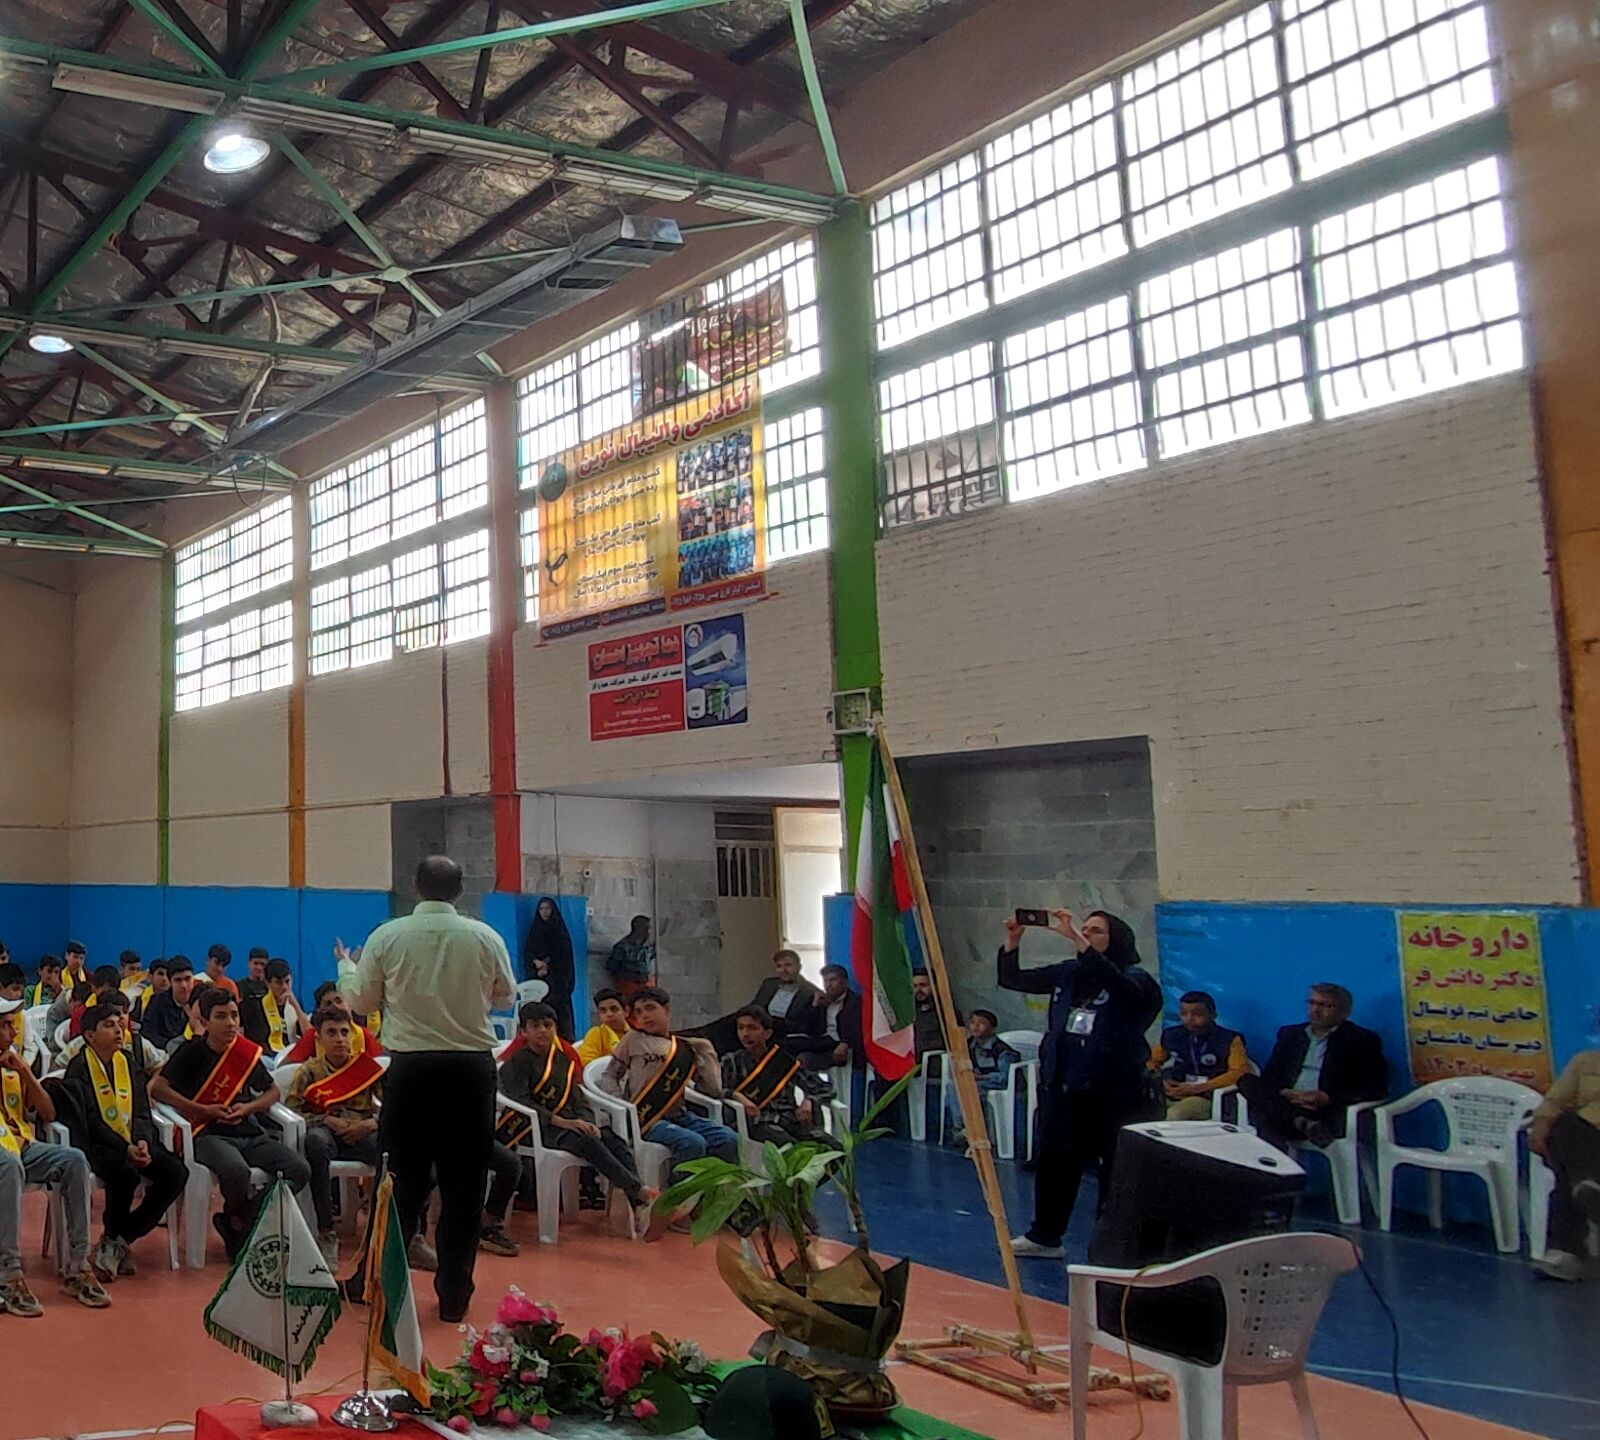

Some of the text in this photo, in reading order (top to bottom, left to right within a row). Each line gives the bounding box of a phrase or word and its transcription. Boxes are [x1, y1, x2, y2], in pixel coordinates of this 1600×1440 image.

[579, 386, 751, 476] آکادمی والیبال نوین
[1408, 925, 1531, 957] داروخانه
[1412, 965, 1534, 991] دکتر دانش فر
[1412, 1001, 1538, 1023] حامی تیم فوتسال
[1475, 1034, 1543, 1053] دبیرستان
